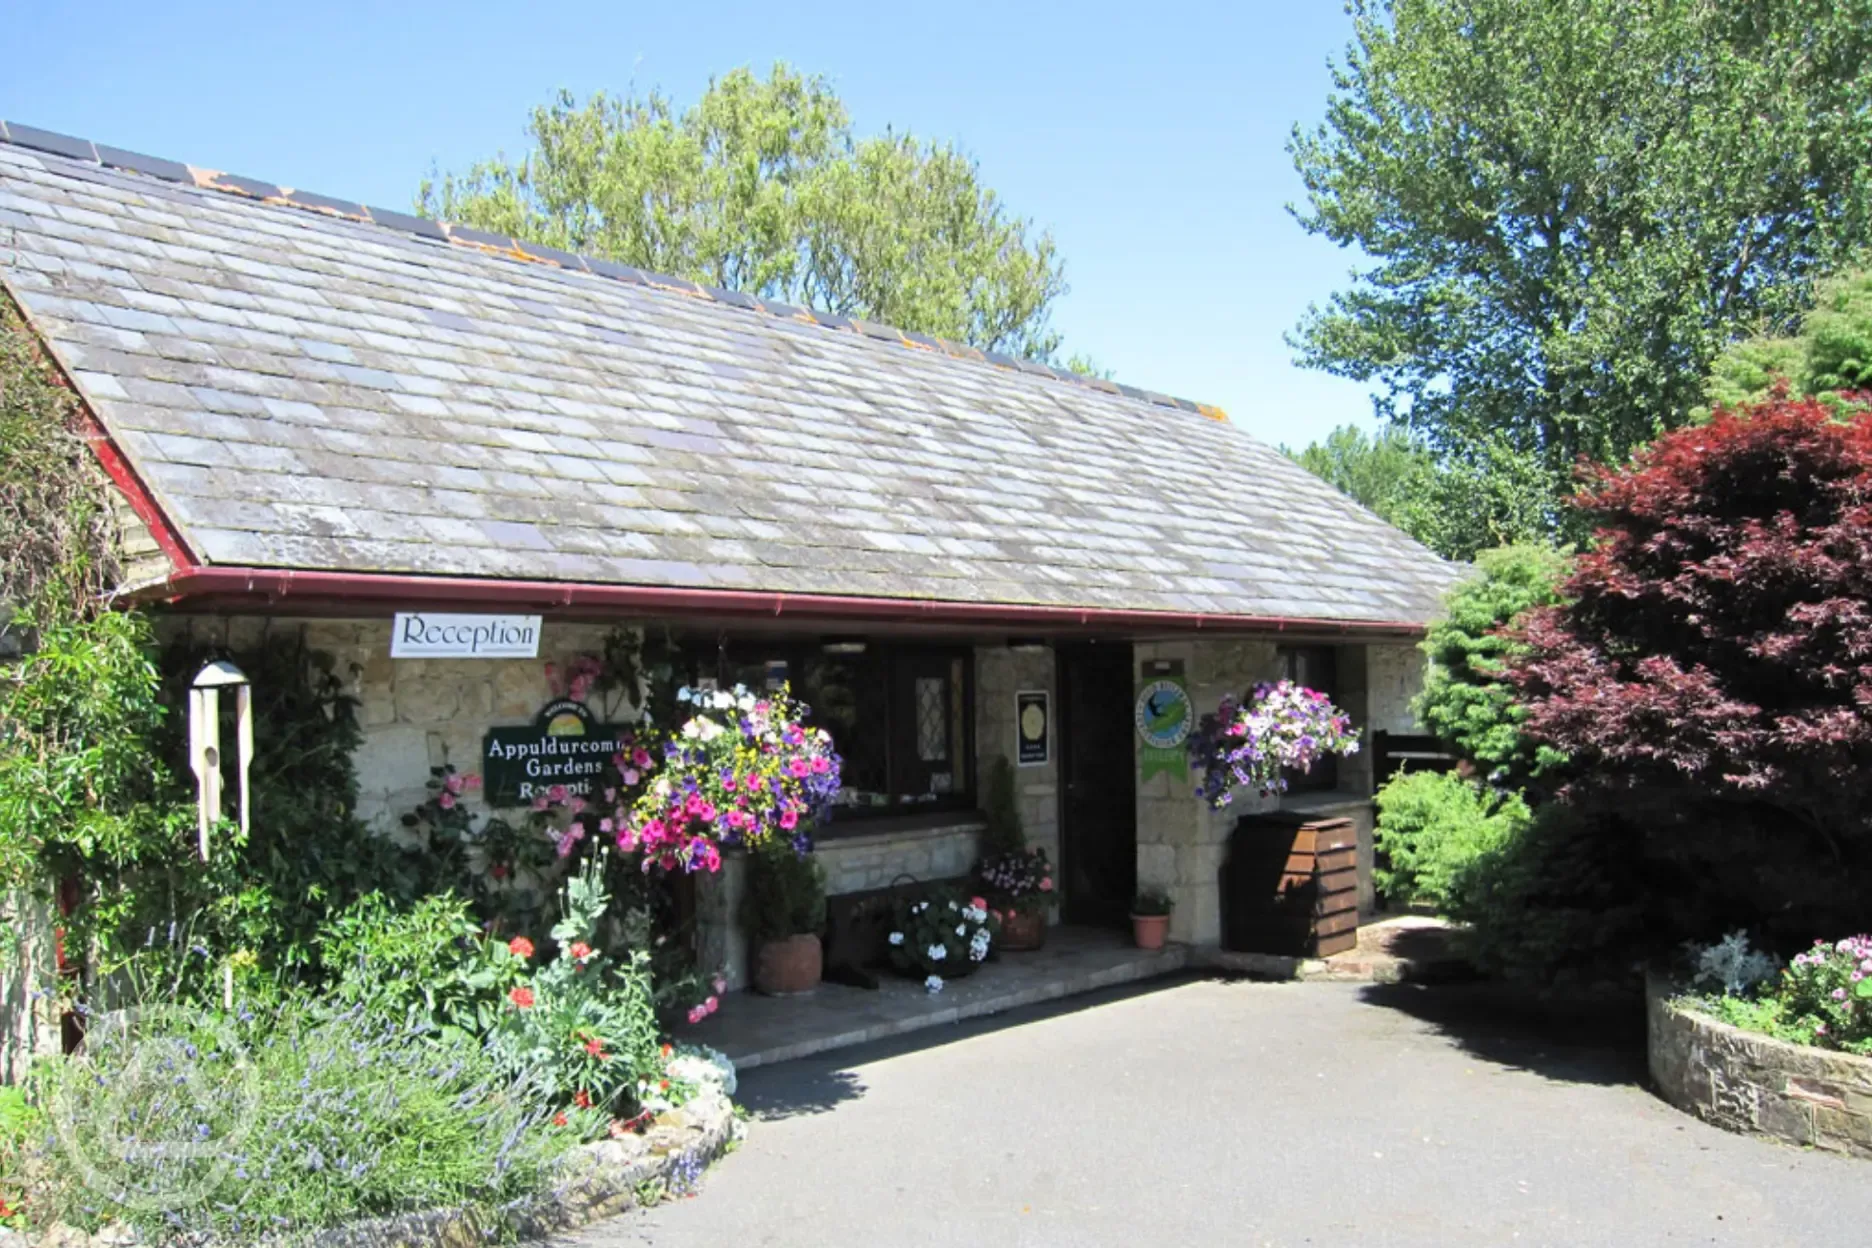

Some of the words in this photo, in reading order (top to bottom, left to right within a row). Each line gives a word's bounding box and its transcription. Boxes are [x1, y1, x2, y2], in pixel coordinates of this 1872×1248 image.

[403, 615, 534, 653] Reception
[488, 736, 625, 761] Appuldurcom
[526, 757, 603, 777] Gardens
